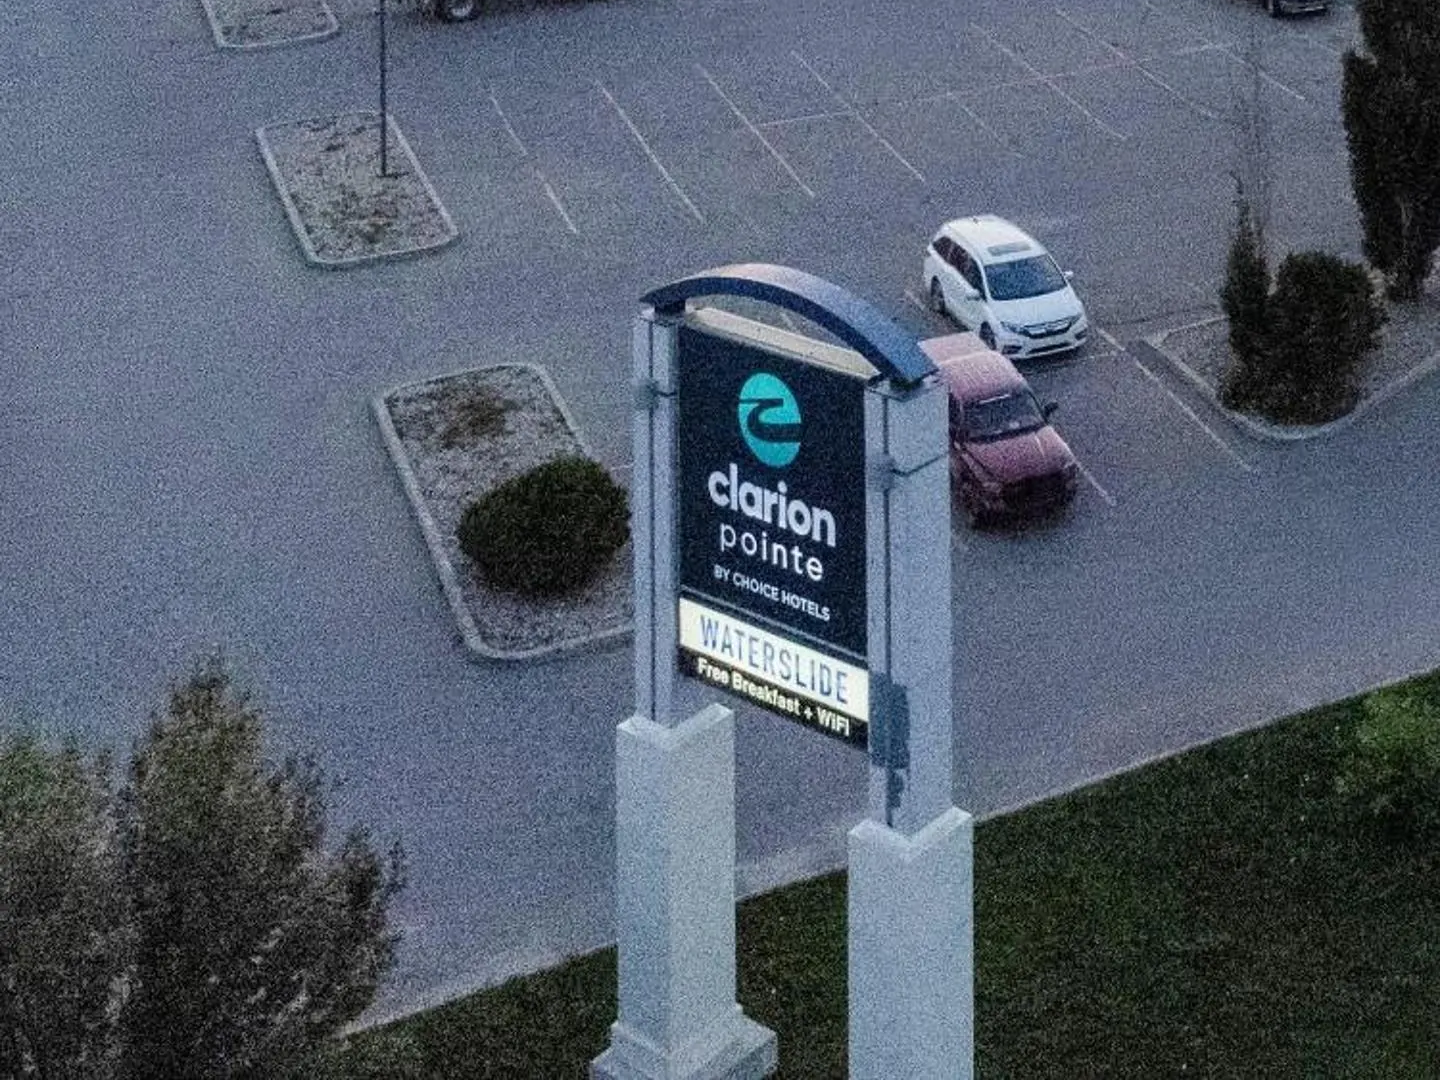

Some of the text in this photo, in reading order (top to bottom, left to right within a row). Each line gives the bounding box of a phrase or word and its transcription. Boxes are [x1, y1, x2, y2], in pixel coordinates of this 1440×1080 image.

[708, 462, 836, 548] clarion
[720, 522, 823, 582] pointe
[713, 564, 831, 622] BY CHOICE HOTELS
[697, 656, 730, 685] Free
[731, 670, 801, 717] Breakfast
[700, 614, 849, 705] WATERSLIDE
